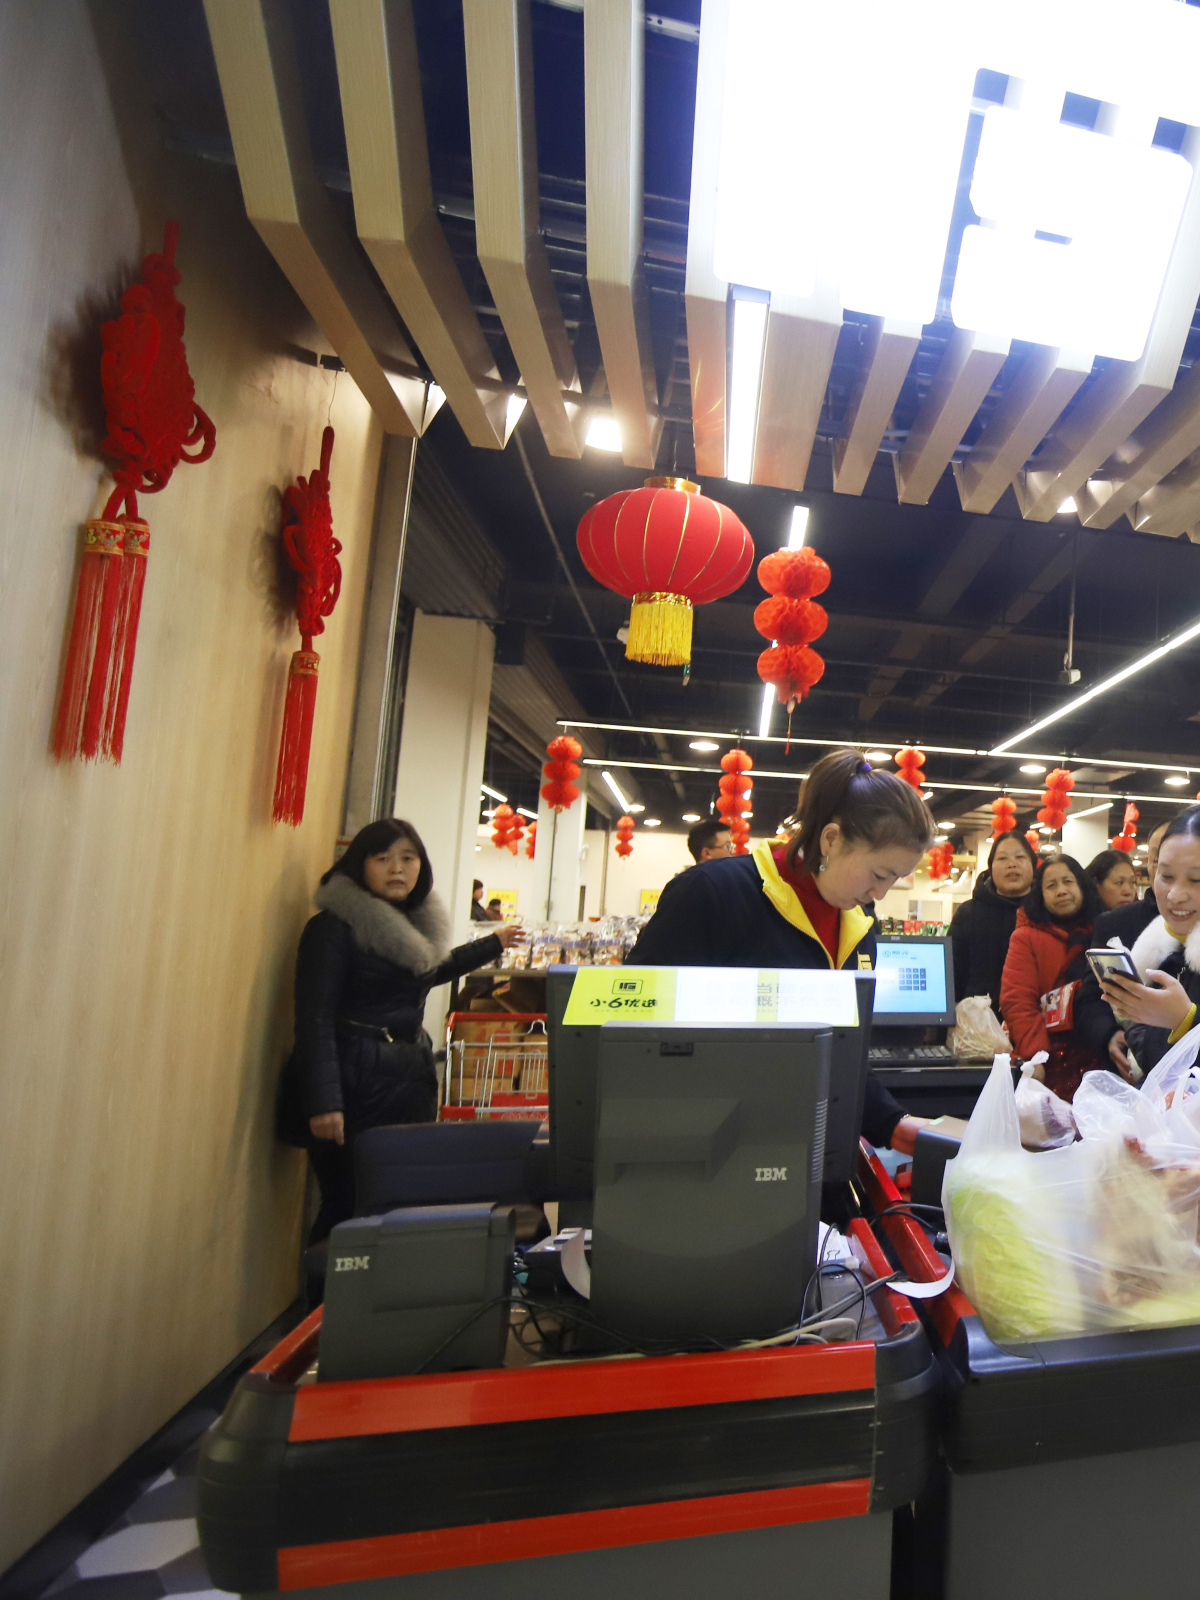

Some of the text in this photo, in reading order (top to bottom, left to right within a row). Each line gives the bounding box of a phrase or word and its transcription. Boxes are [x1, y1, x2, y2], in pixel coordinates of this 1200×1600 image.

[589, 997, 658, 1009] 小6优选
[755, 1167, 787, 1181] IBM
[335, 1255, 369, 1272] IBM
